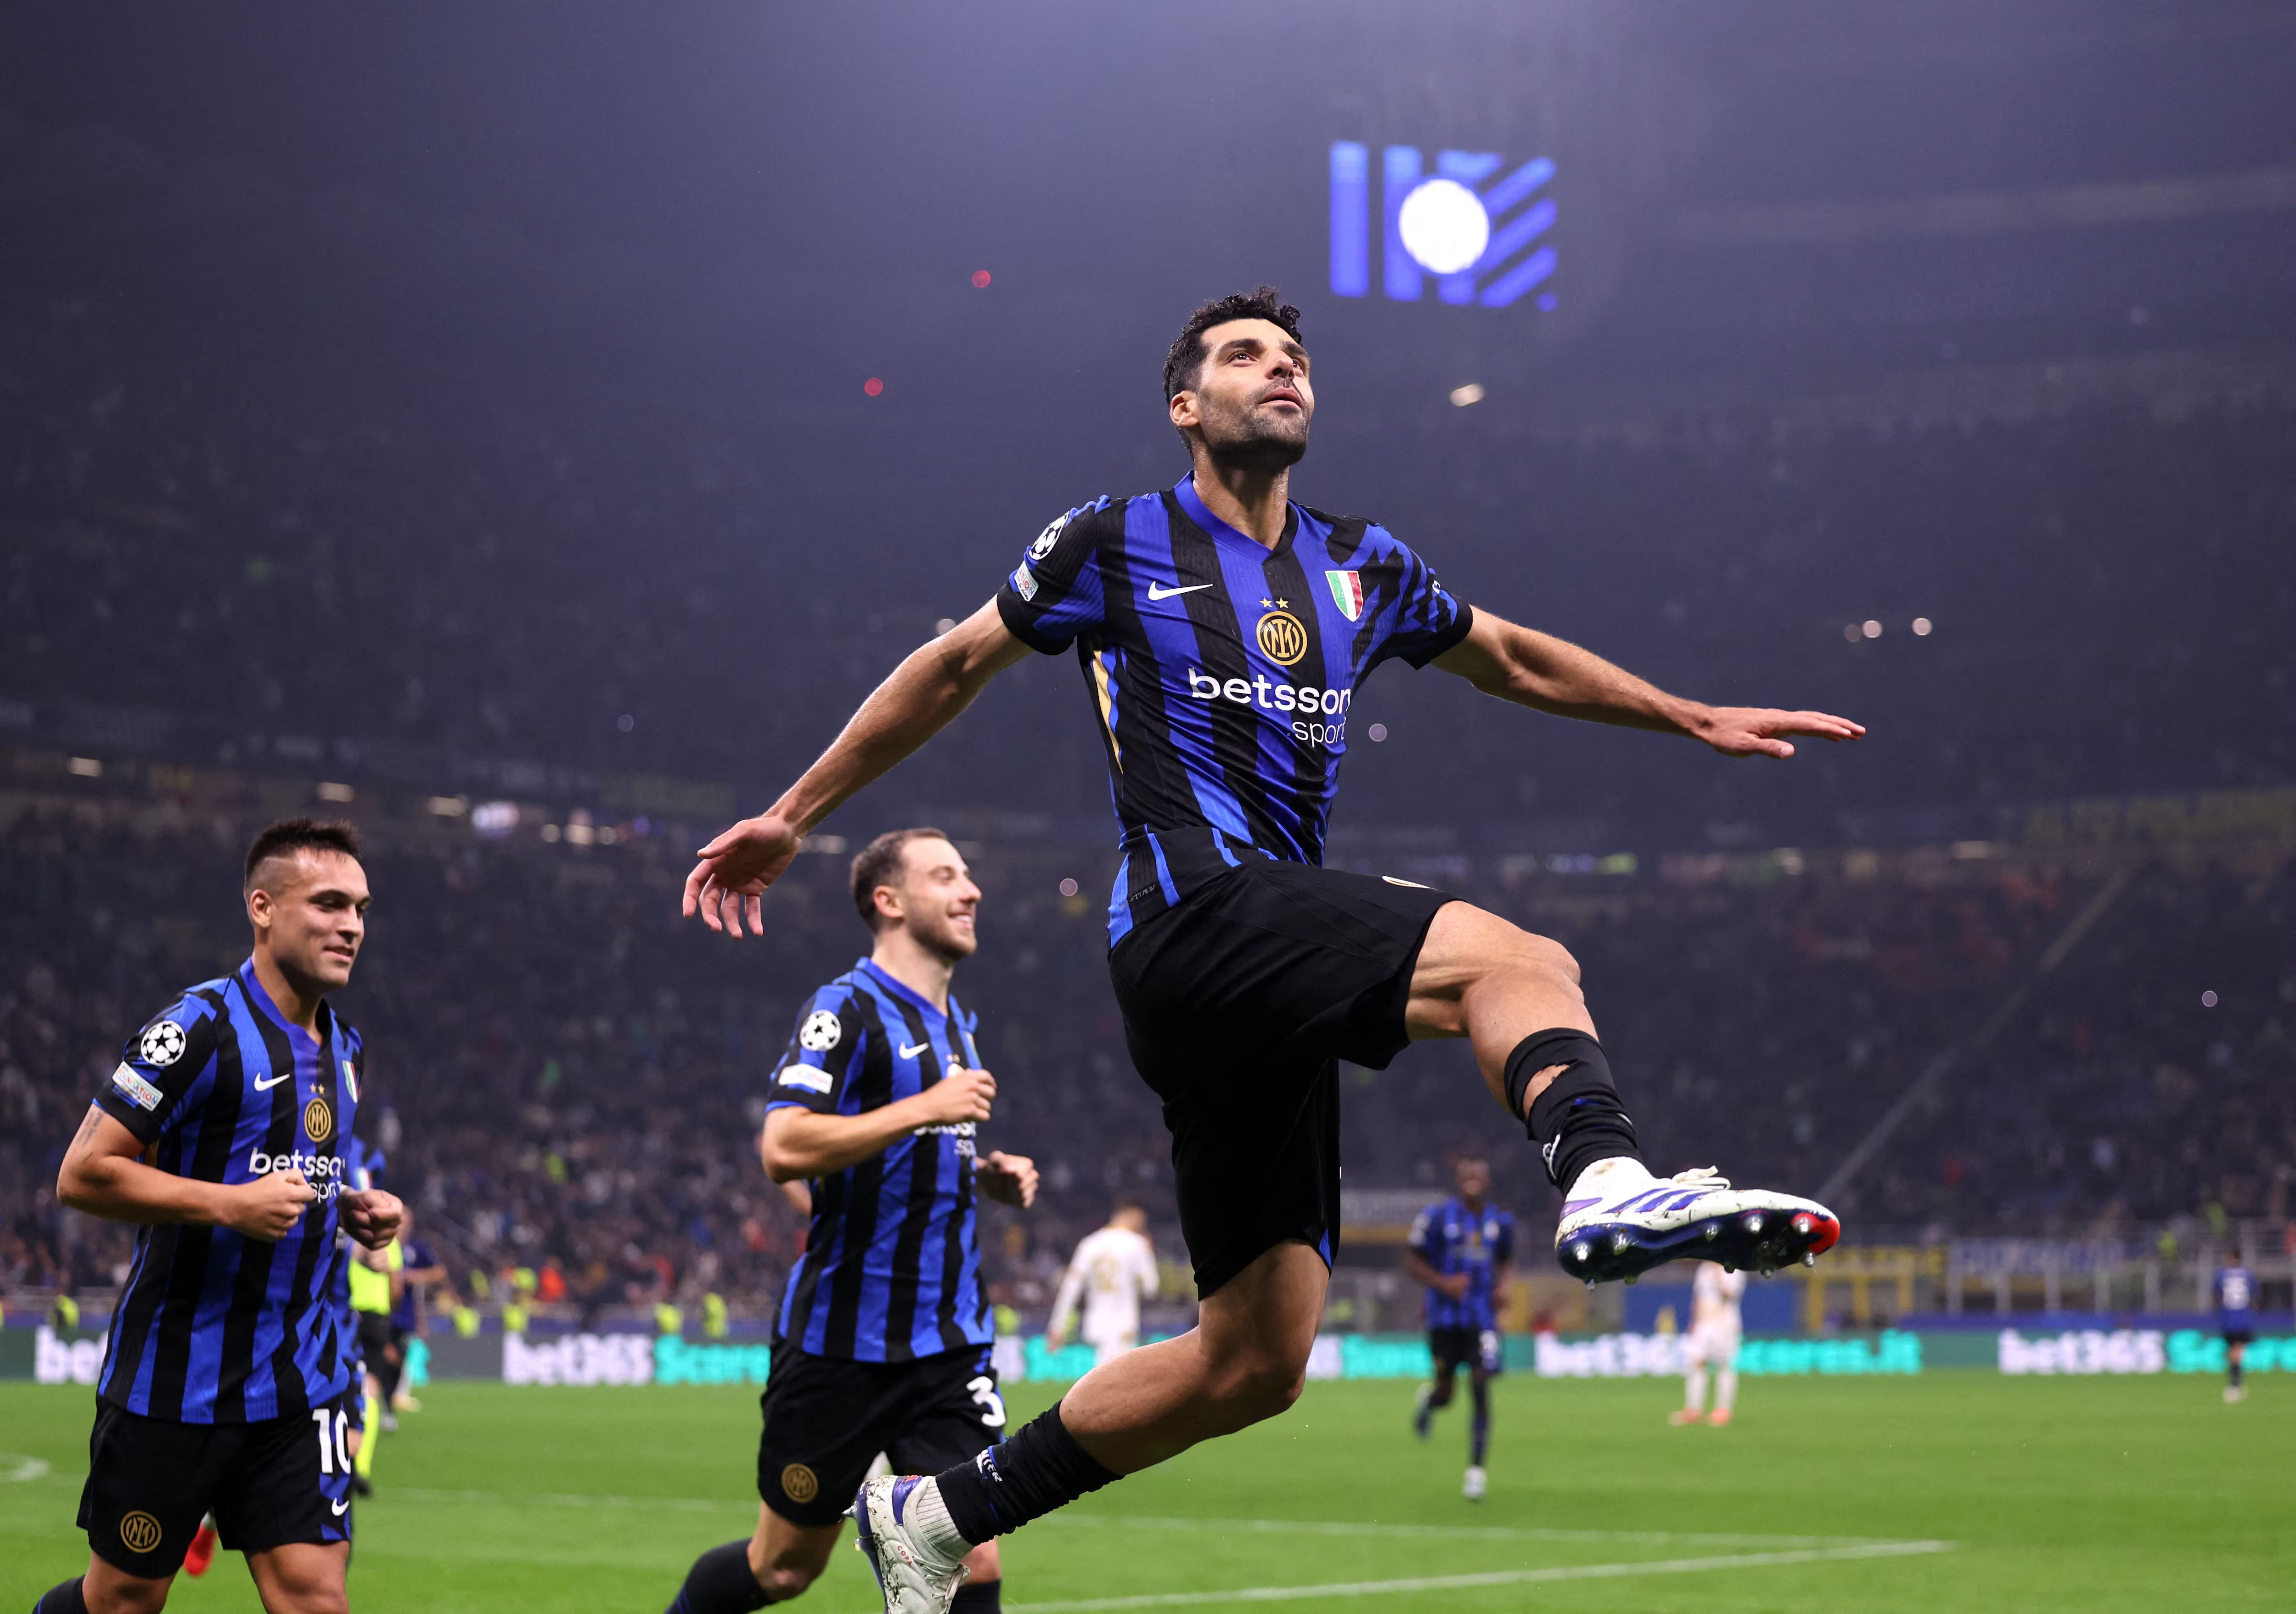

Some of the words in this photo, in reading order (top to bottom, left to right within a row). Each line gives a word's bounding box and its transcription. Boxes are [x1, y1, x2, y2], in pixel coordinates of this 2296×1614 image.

[1188, 667, 1351, 715] betsson
[248, 1147, 345, 1178] betsso
[312, 1408, 351, 1474] 10
